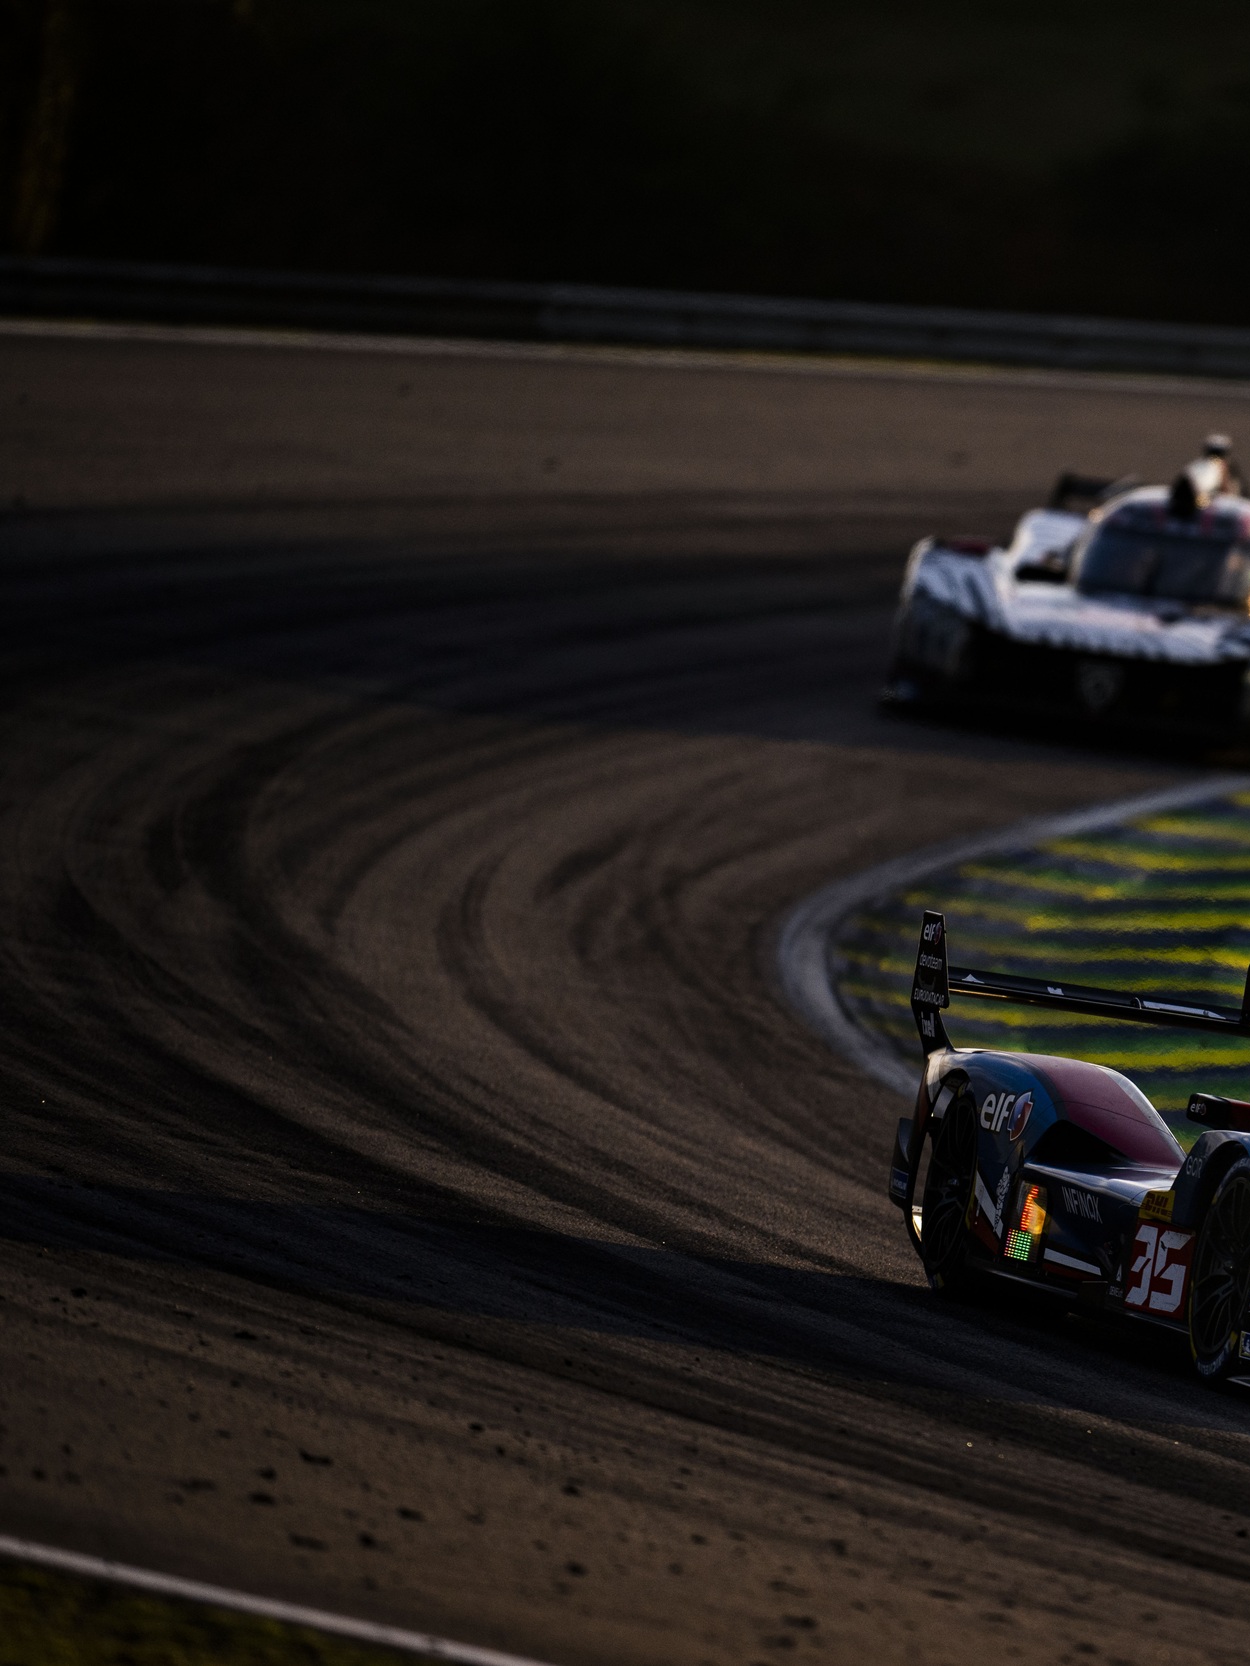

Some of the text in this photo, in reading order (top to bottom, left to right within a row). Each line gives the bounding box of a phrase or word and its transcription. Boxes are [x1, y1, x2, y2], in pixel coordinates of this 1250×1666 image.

[923, 923, 936, 942] elf
[919, 951, 942, 971] devoteam
[913, 988, 945, 1006] EURODATACAR
[980, 1092, 1016, 1132] elf
[1189, 1102, 1201, 1113] elf
[1061, 1185, 1103, 1224] INFINOX
[1124, 1223, 1193, 1313] 35
